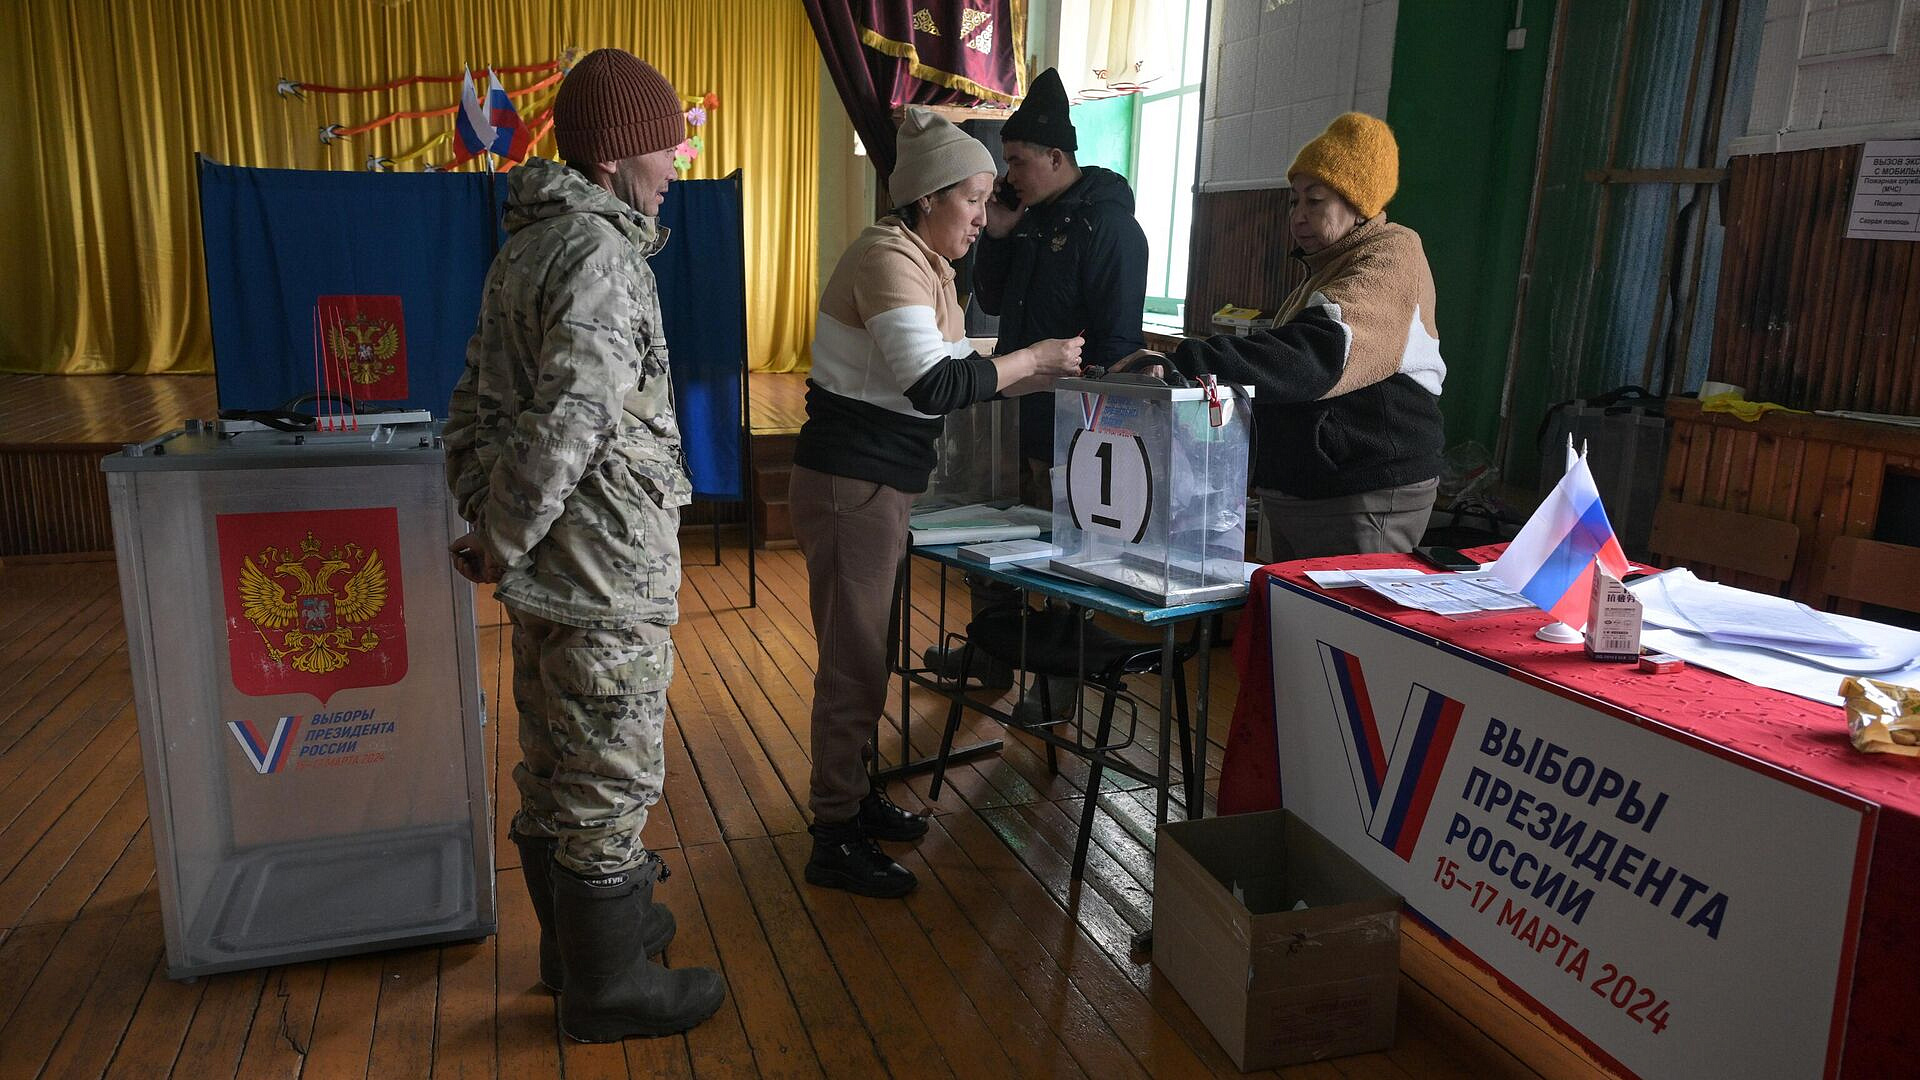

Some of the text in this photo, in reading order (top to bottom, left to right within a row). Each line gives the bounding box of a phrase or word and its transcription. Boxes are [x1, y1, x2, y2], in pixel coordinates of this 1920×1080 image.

[1873, 158, 1903, 166] ВЫЗОВ
[1882, 185, 1902, 193] (МЧС)
[311, 708, 375, 726] ВЫБОРЫ
[304, 722, 395, 742] ПРЕЗИДЕНТА
[299, 741, 357, 757] РОССИИ
[1480, 717, 1669, 833] ВЫБОРЫ
[1462, 766, 1729, 940] ПРЕЗИДЕНТА
[1445, 812, 1595, 925] РОССИИ
[1496, 898, 1590, 982] МАРТА
[1590, 963, 1670, 1034] 2024
